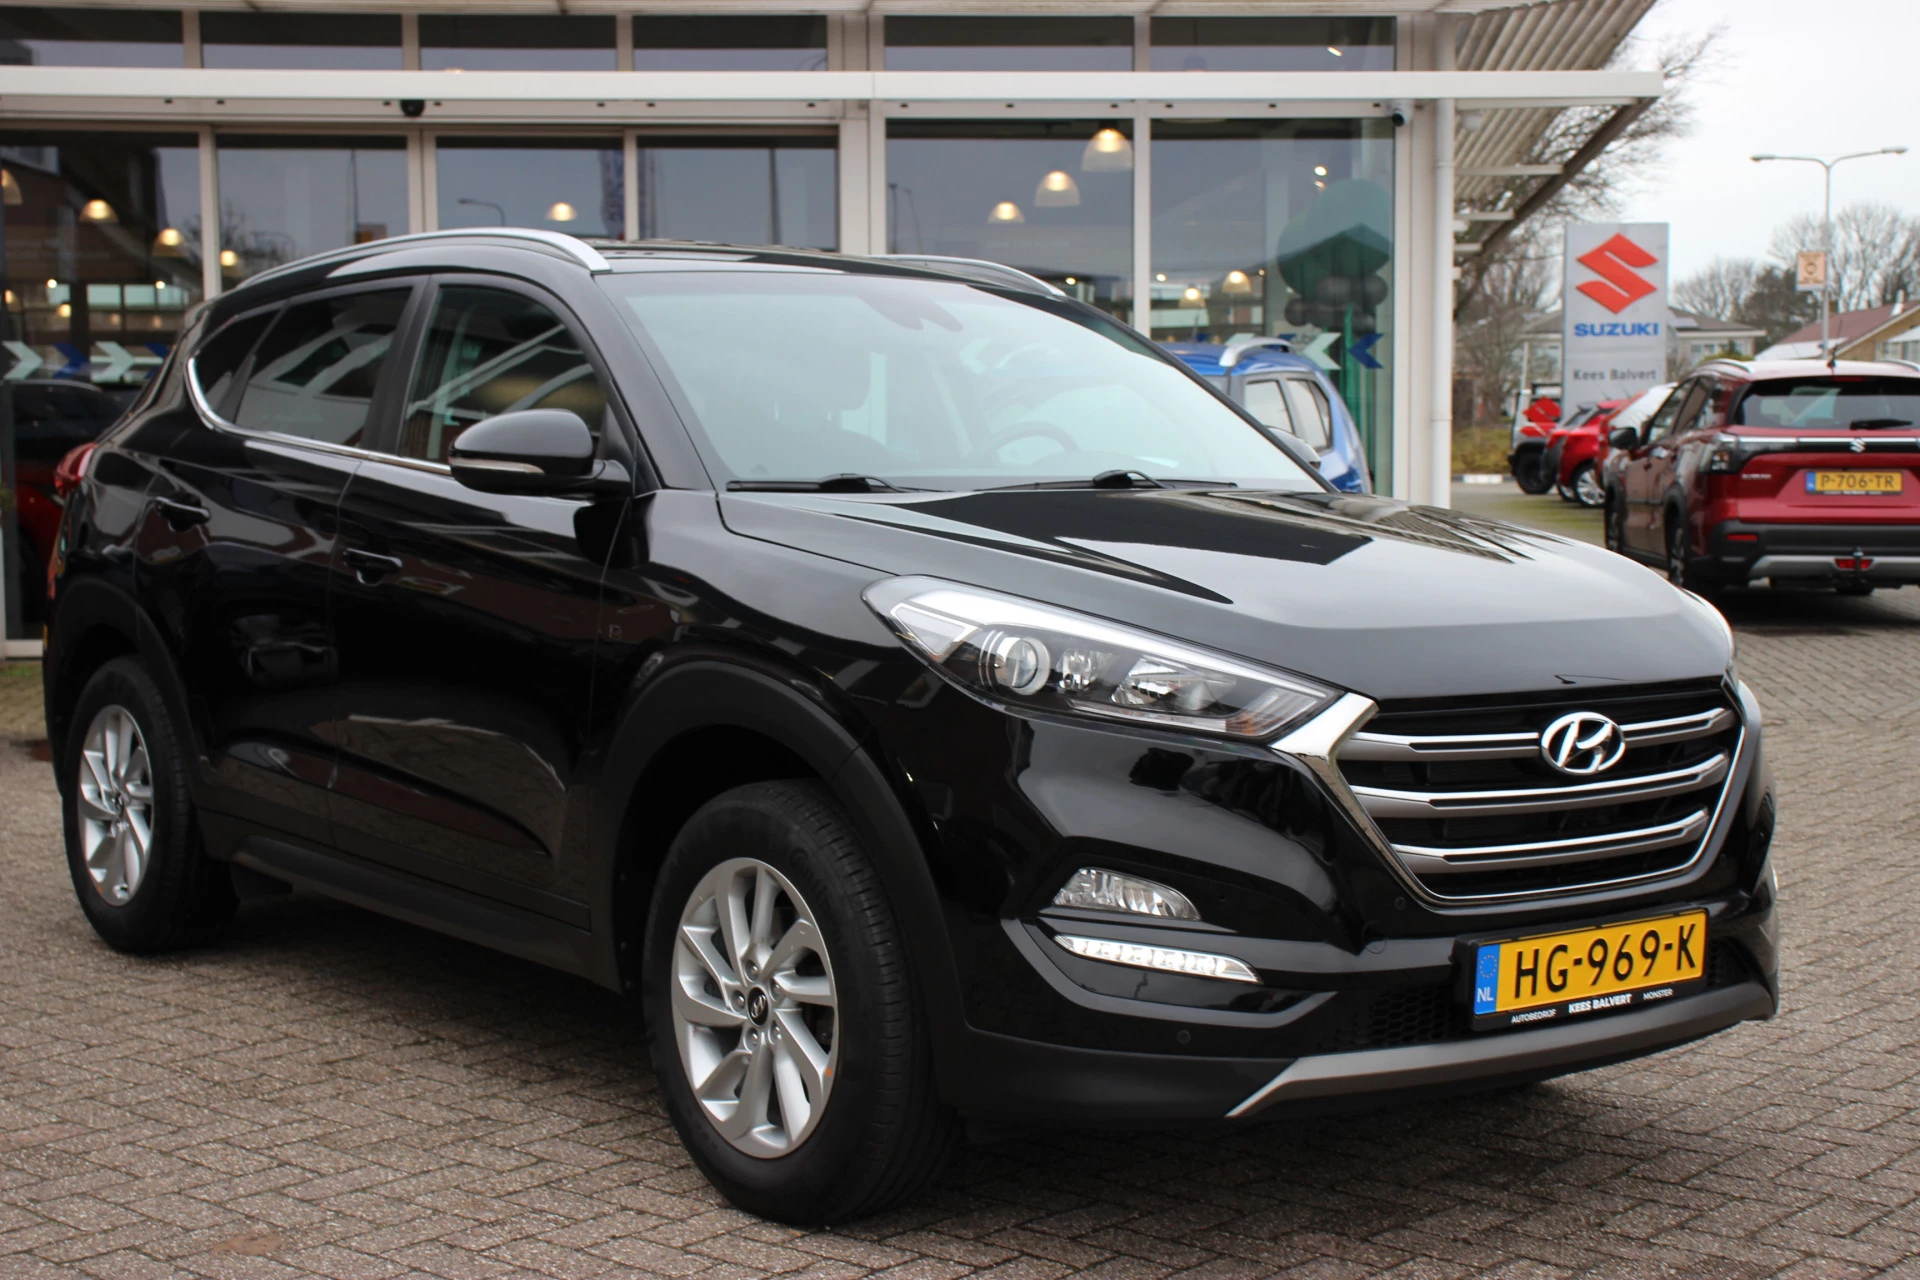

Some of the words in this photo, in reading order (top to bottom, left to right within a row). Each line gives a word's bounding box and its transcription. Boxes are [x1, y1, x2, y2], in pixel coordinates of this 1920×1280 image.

[1574, 323, 1659, 337] SUZUKI
[1573, 369, 1605, 381] Kees
[1610, 368, 1657, 380] Balvert
[1821, 474, 1894, 488] P-706-TR
[1514, 923, 1696, 998] HG-969-K
[1477, 986, 1494, 1002] NL
[1568, 1001, 1592, 1013] KEES
[1592, 994, 1632, 1009] BALVERT
[1643, 989, 1673, 1001] MONSTER
